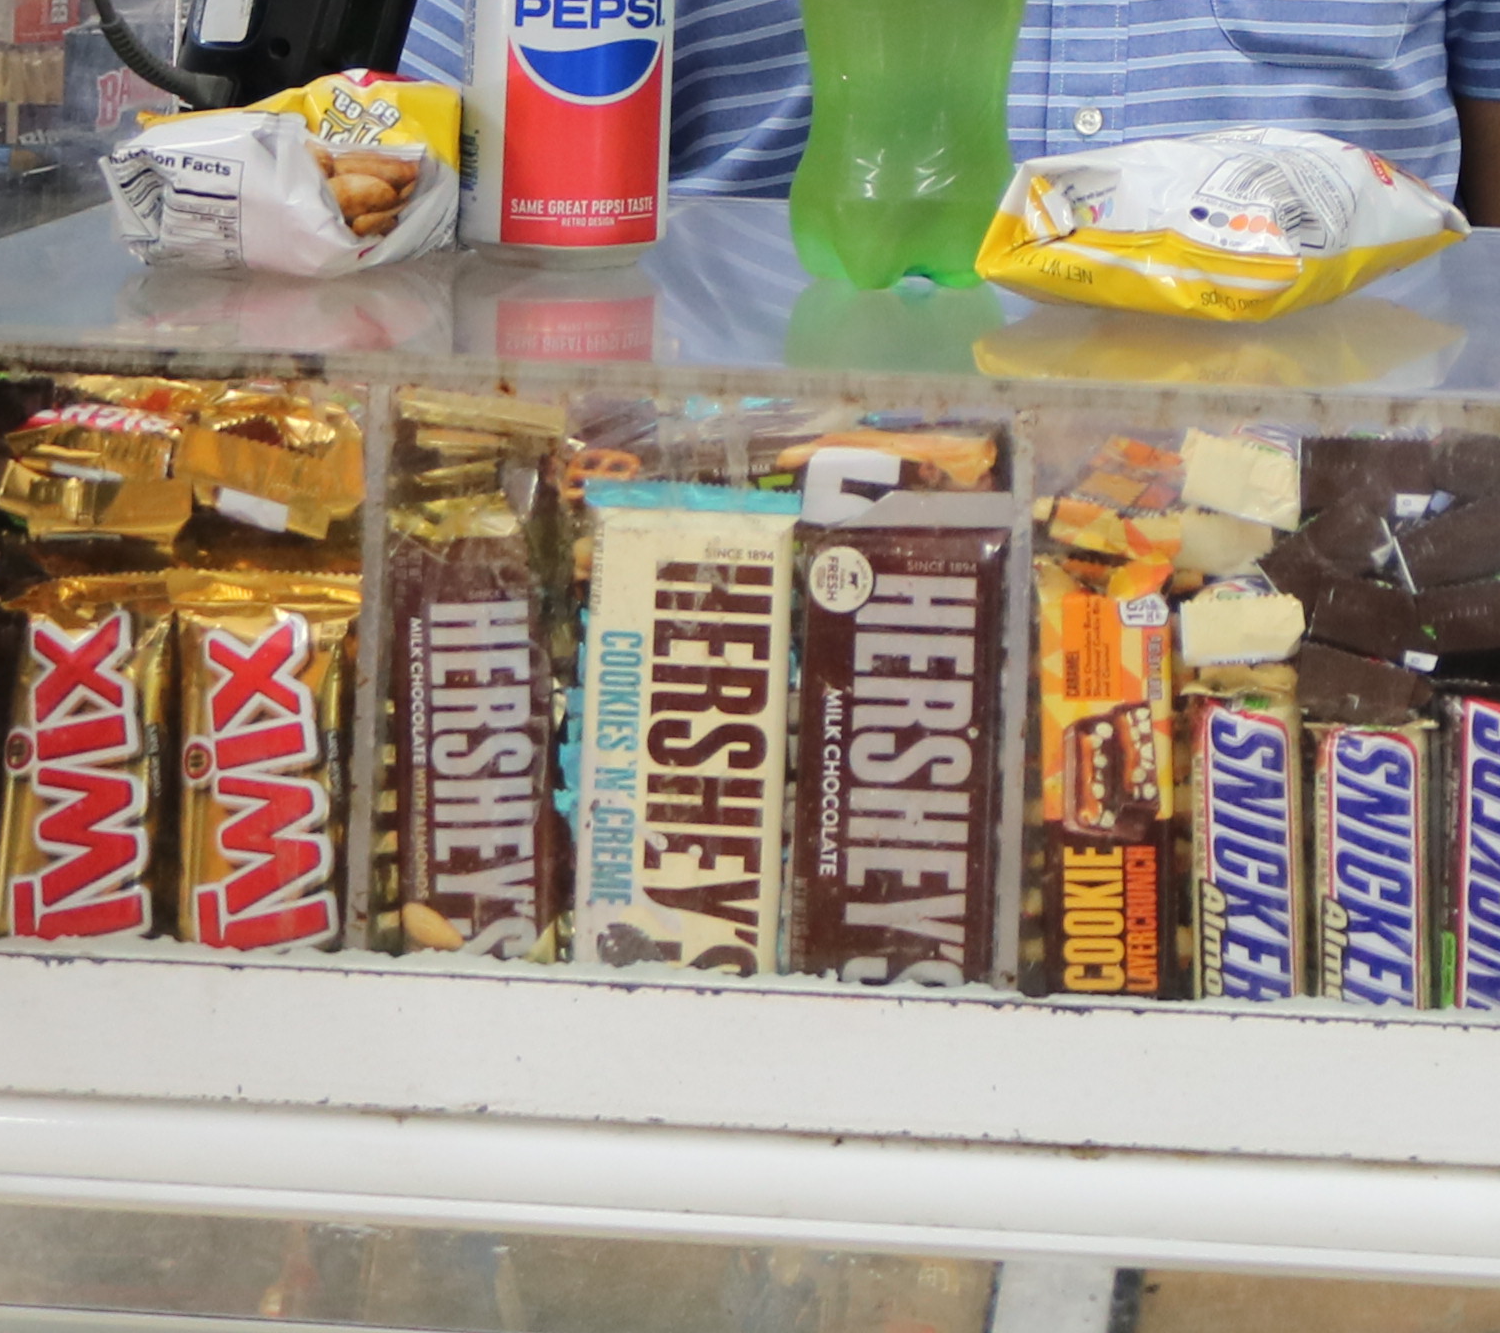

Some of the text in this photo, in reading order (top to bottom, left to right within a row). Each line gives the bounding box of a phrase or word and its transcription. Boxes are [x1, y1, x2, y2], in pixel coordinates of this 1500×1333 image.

[510, 196, 653, 215] SAME GREAT PEPSI TASTE
[819, 689, 843, 876] MILK CHOCOLATE
[1062, 847, 1124, 991] COOKIE
